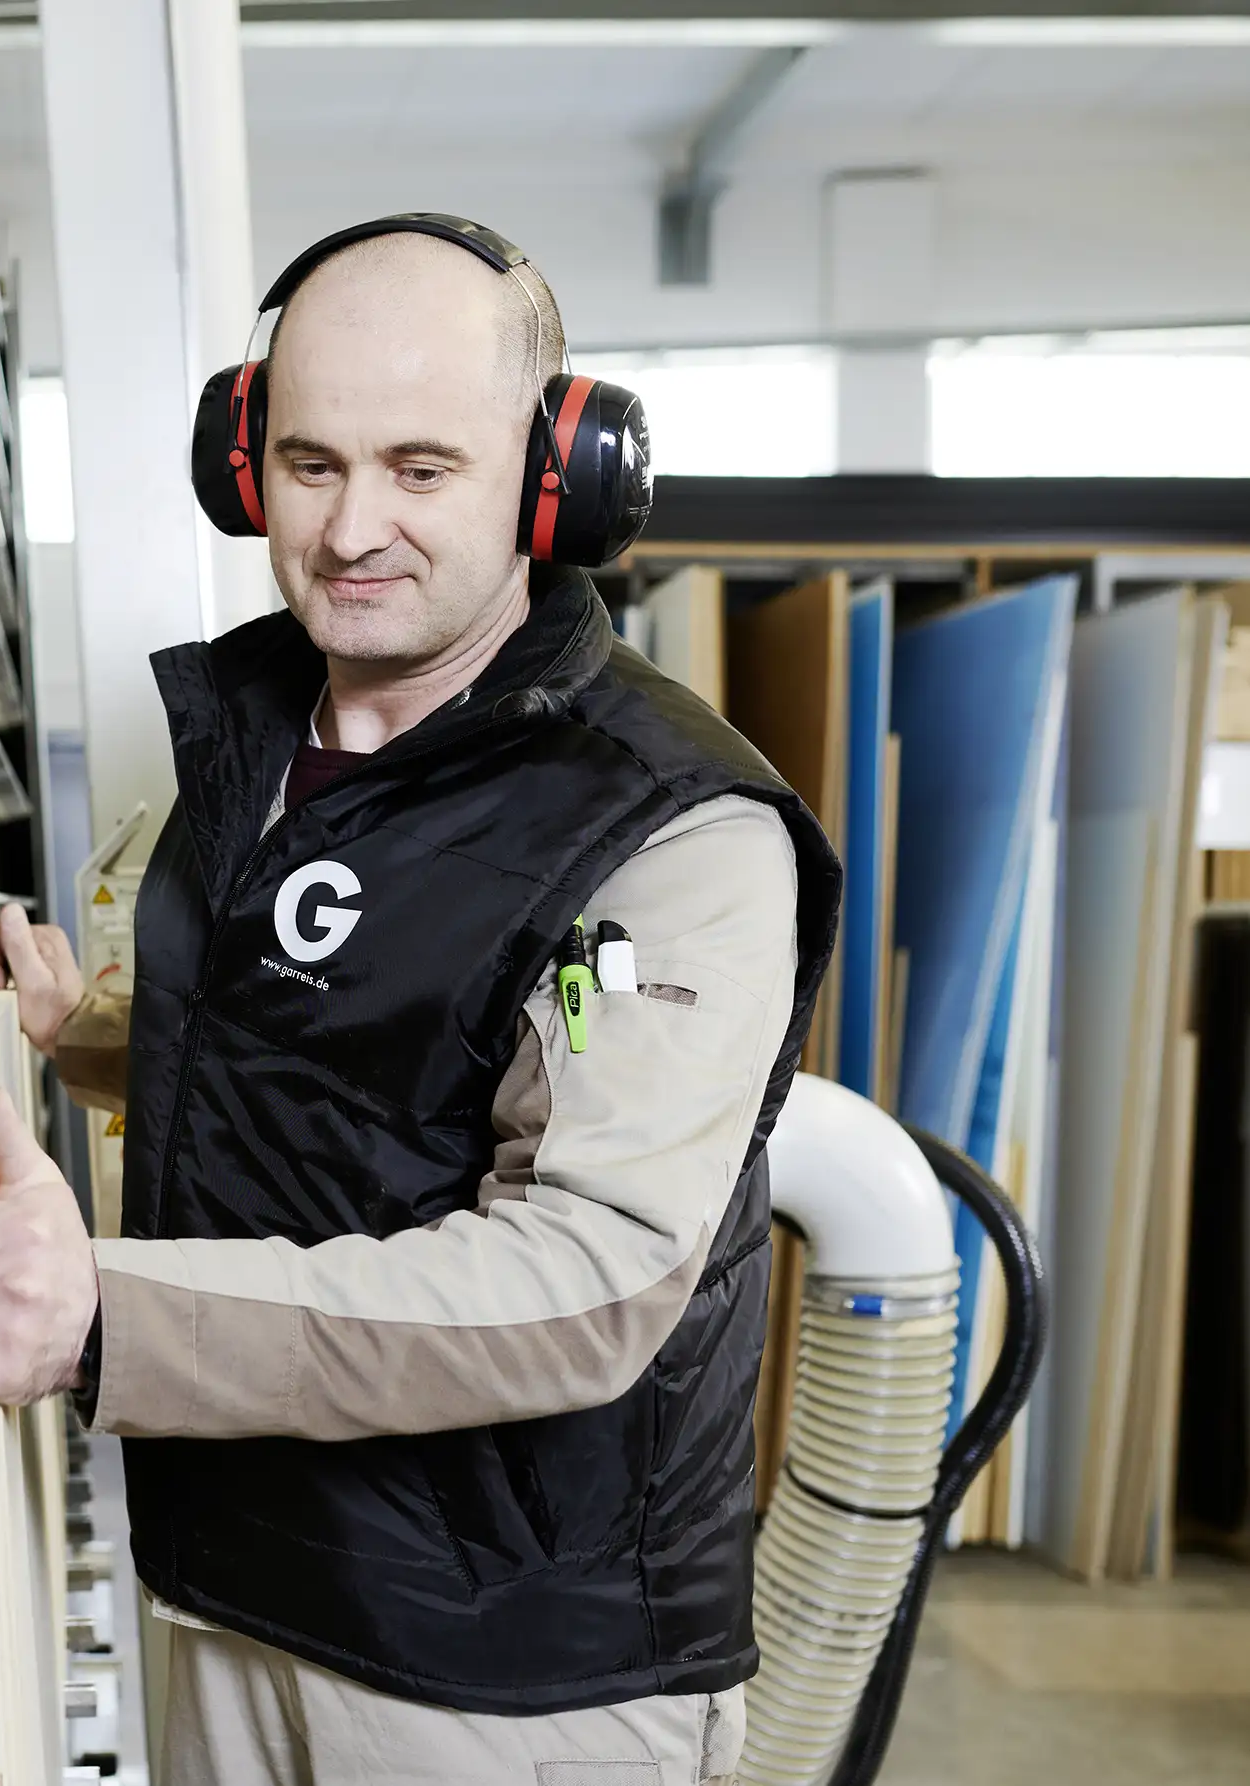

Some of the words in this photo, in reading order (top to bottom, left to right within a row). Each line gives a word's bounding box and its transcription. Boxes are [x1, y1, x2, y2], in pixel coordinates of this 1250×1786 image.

[274, 860, 362, 962] G
[261, 956, 330, 991] www.garreis.de
[569, 984, 579, 1008] Pica
